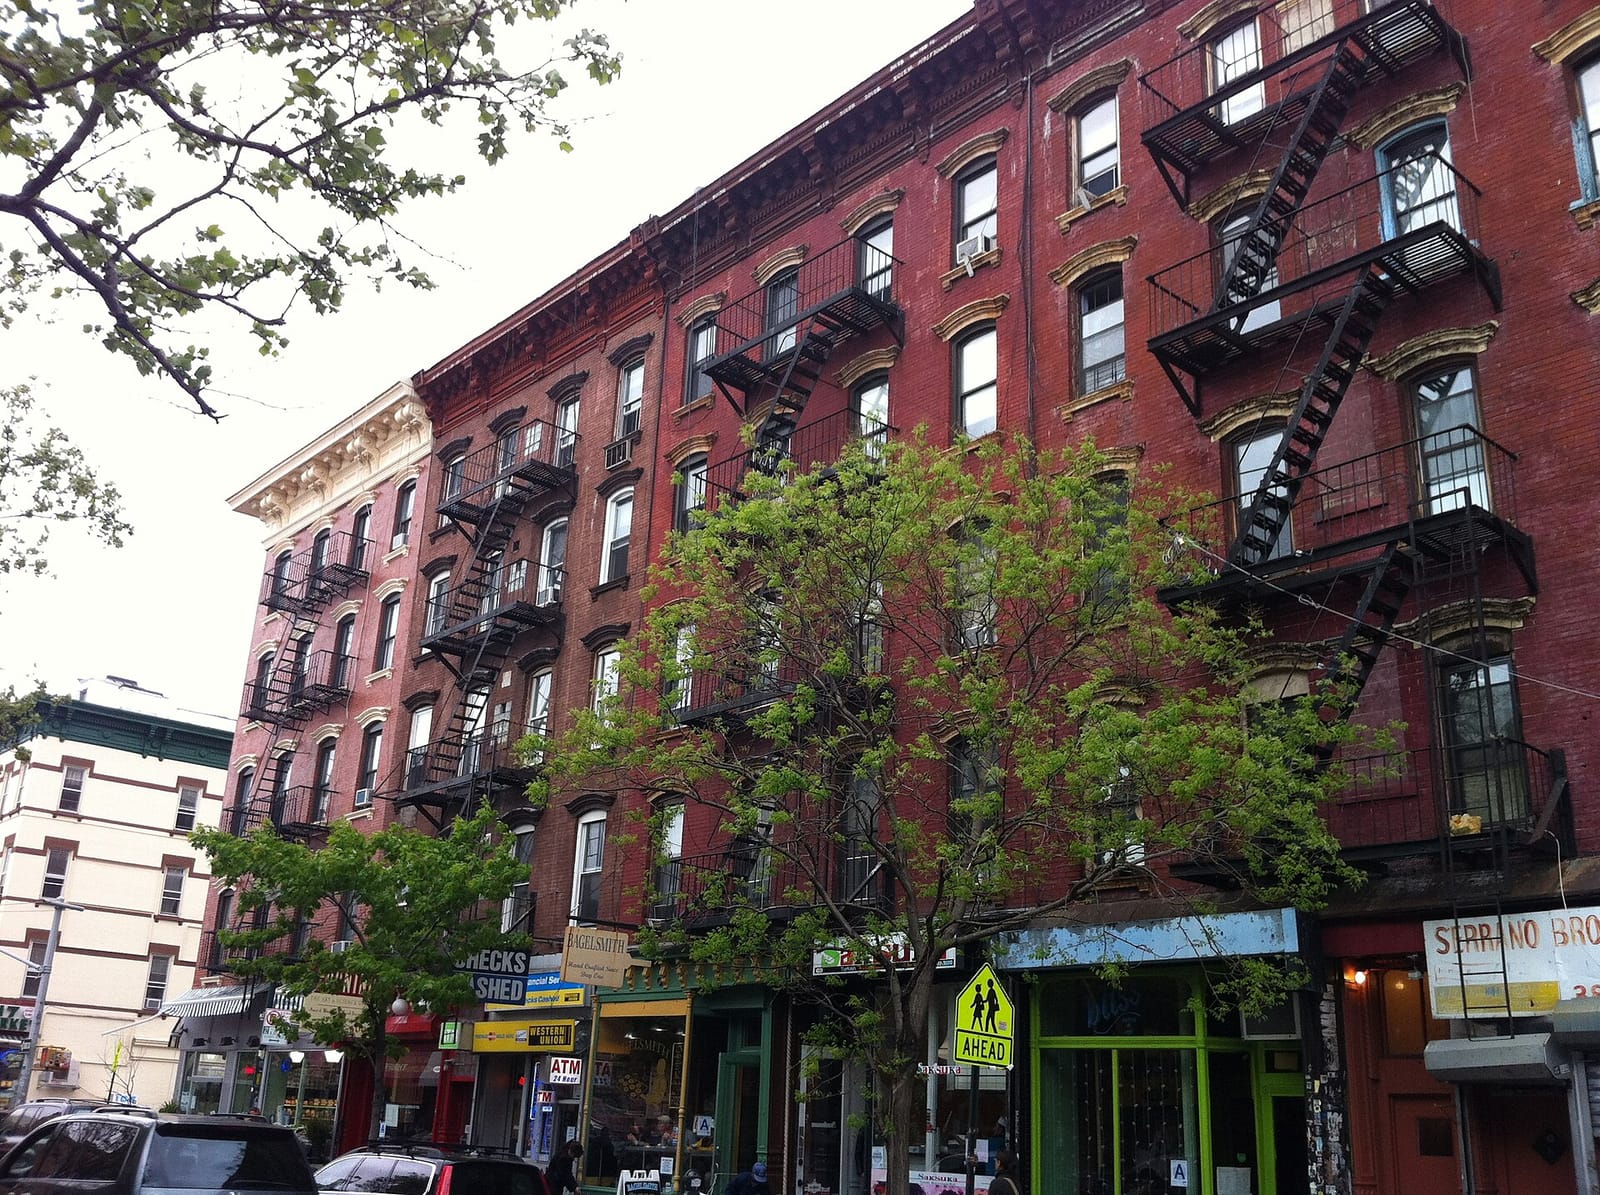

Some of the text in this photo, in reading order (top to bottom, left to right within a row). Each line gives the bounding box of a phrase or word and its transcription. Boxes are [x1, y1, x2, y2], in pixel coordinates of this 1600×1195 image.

[568, 932, 625, 954] BAGELSMITH
[1434, 919, 1540, 955] SERRANO
[470, 976, 524, 1001] SHED
[530, 1026, 565, 1036] WESTERN
[540, 1035, 565, 1044] UNION
[963, 1037, 1005, 1061] AHEAD
[551, 1059, 580, 1075] ATM
[700, 1119, 709, 1131] A
[1174, 1164, 1186, 1179] A
